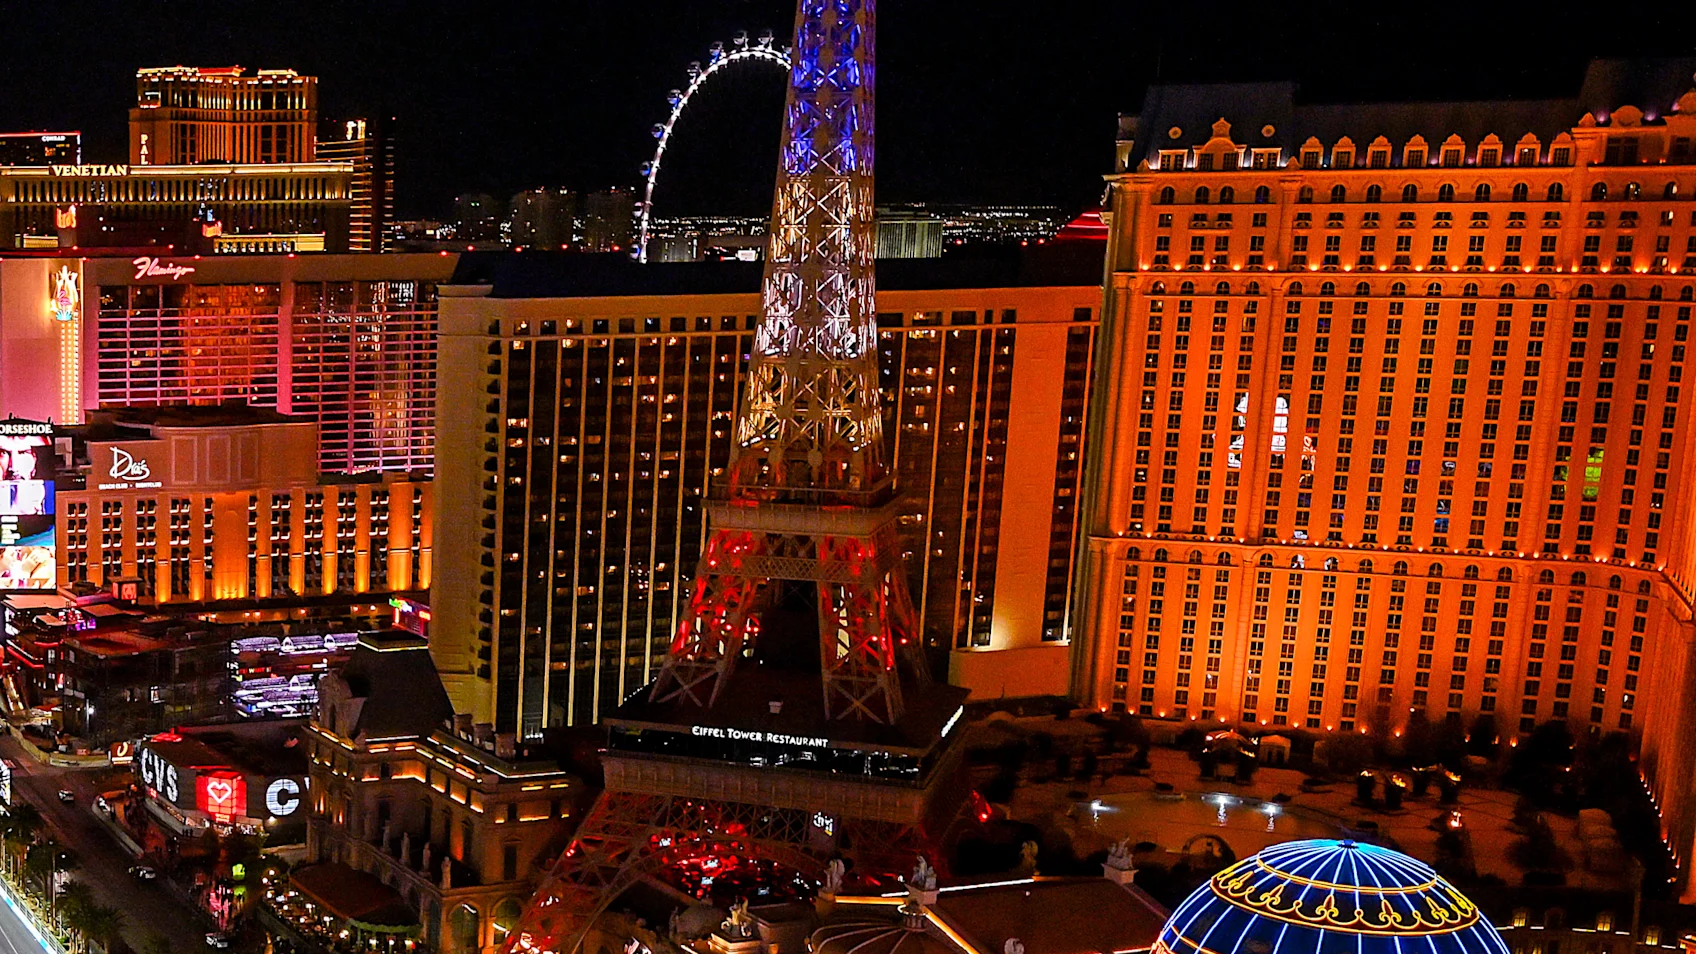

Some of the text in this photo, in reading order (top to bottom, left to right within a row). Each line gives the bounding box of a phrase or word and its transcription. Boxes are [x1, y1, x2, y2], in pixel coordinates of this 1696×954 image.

[52, 164, 128, 176] VENETIAN
[133, 257, 195, 280] Flamingo
[692, 725, 829, 748] EIFFEL TOWER RESTAURANT
[141, 748, 179, 803] CVS
